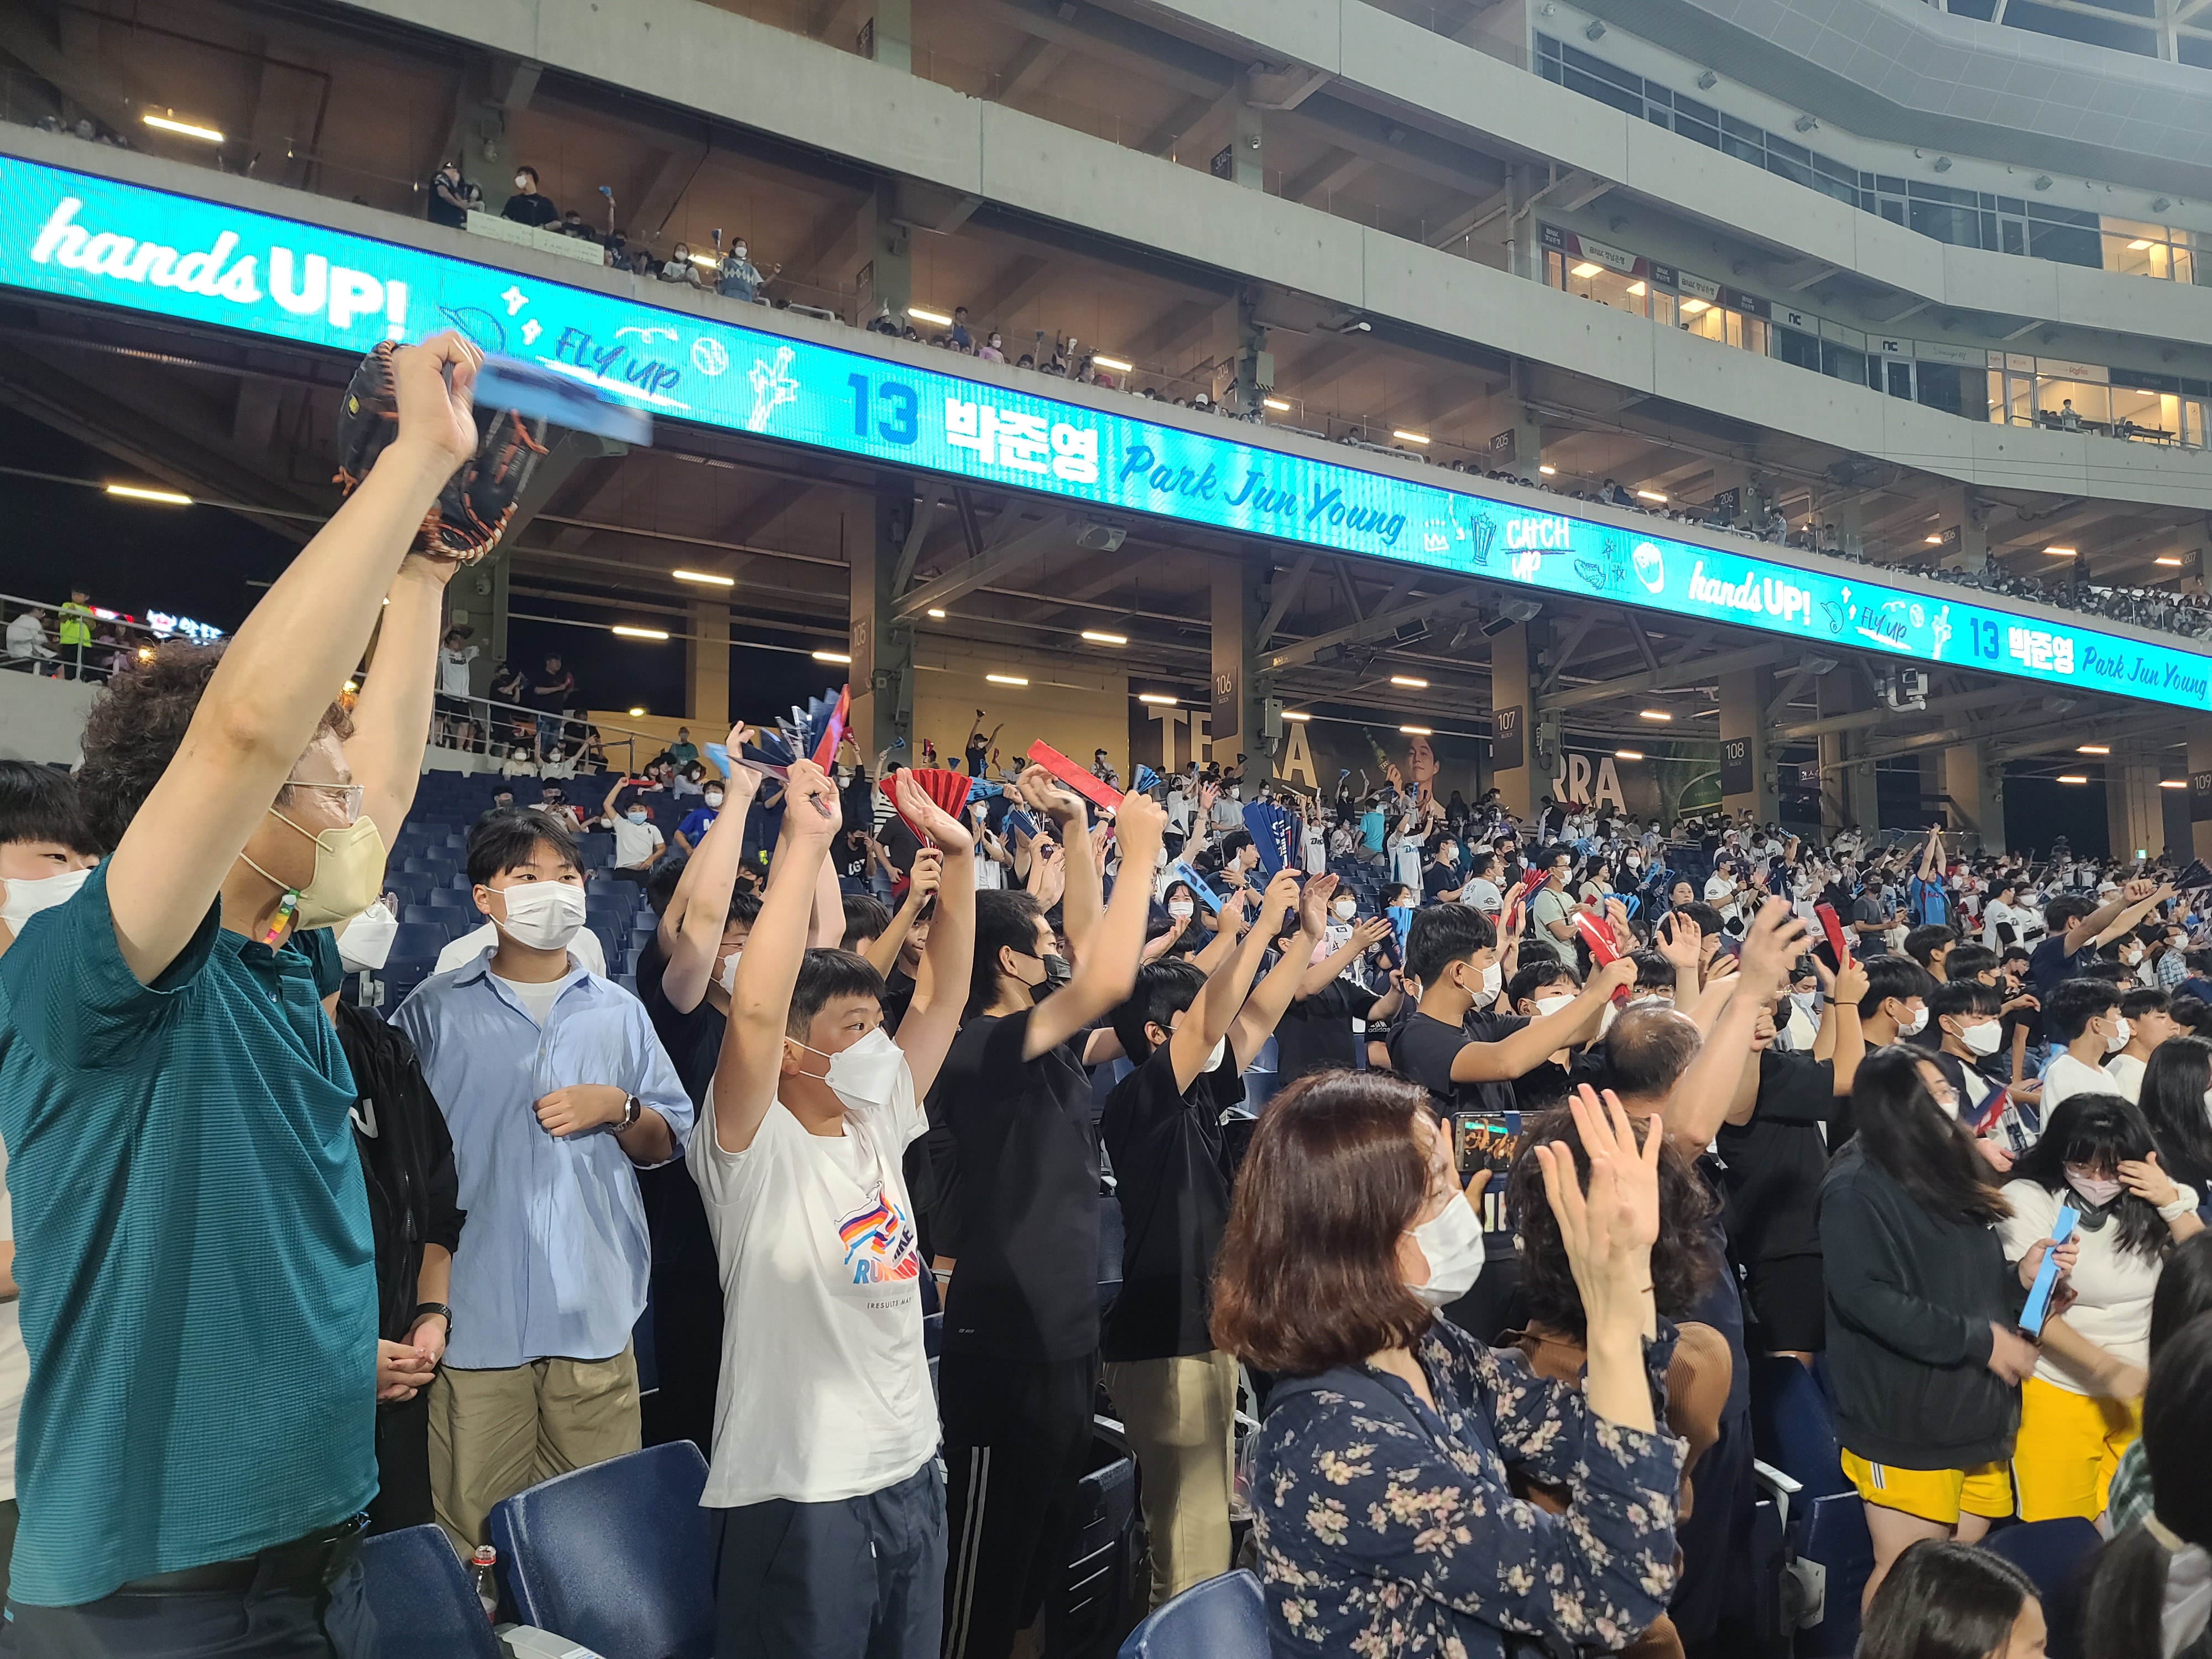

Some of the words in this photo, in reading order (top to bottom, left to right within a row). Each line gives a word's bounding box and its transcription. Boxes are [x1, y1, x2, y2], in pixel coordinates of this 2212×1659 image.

[1589, 246, 1604, 257] BNK
[1604, 251, 1625, 265] 경남은행
[32, 196, 262, 304] hands
[269, 247, 409, 341] UP!
[1681, 278, 1695, 289] BNK
[1217, 362, 1229, 380] 204
[1495, 433, 1508, 449] 205
[847, 373, 919, 446] 13
[945, 397, 1099, 484] 박준영
[1119, 444, 1218, 500] Park
[1223, 470, 1298, 518] Jun
[1306, 483, 1406, 546] Young
[1720, 491, 1733, 504] 206
[1506, 518, 1569, 549] CATCH
[2184, 551, 2196, 564] 207
[1688, 561, 1764, 609] hands
[1762, 577, 1811, 626] UP!
[854, 622, 866, 648] 105
[1970, 617, 2000, 660] 13
[2008, 626, 2075, 675] 박준영
[2082, 646, 2124, 679] Park
[2127, 655, 2160, 686] Jun
[2163, 661, 2209, 701] Young
[1216, 673, 1232, 695] 106
[1498, 711, 1515, 731] 107
[1725, 742, 1745, 760] 108
[2194, 774, 2211, 790] 109
[867, 1301, 899, 1310] (RESULTS
